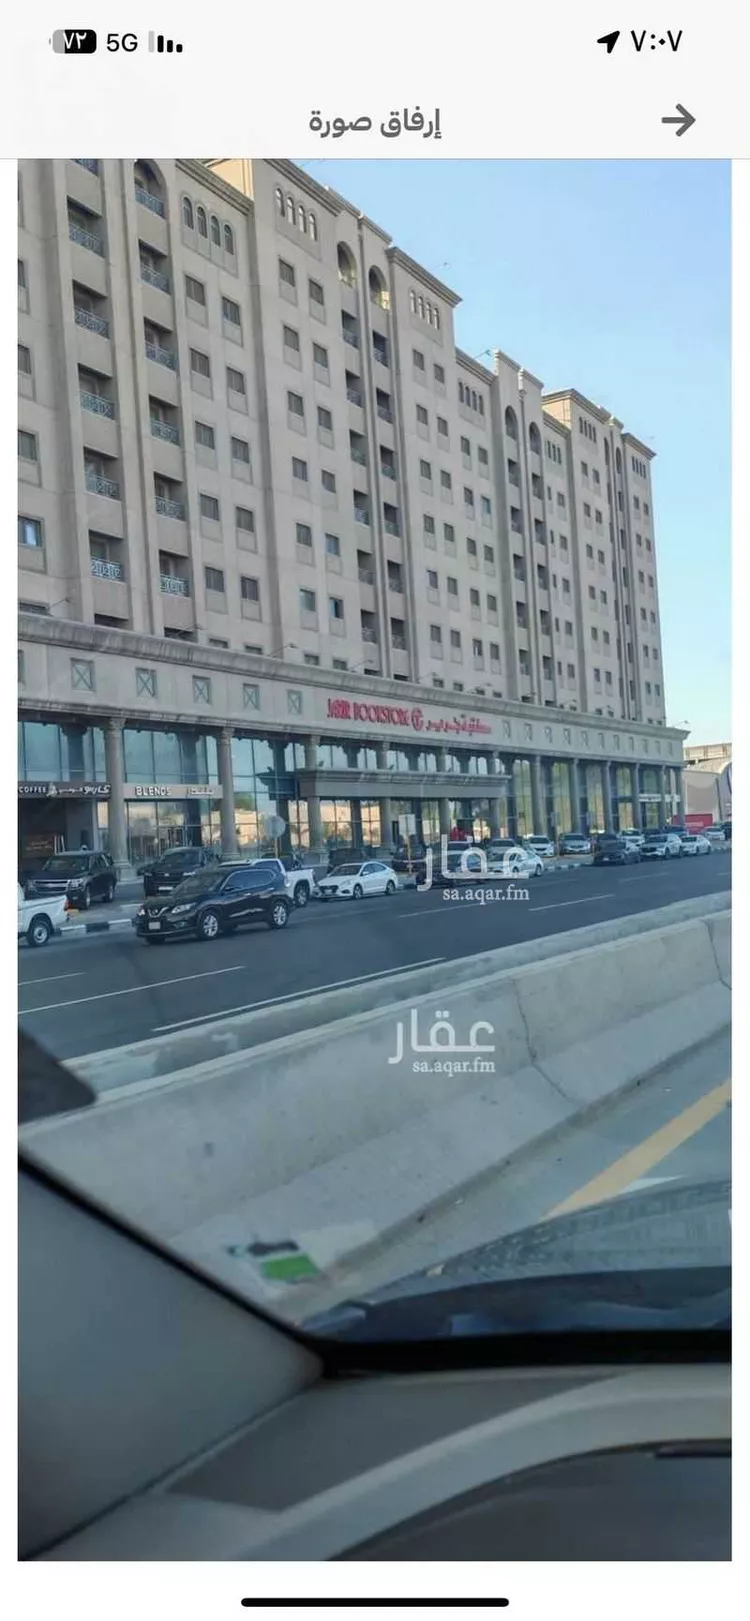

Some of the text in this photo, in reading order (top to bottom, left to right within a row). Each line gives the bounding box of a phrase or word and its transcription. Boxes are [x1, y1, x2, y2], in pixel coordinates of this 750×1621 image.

[106, 33, 138, 52] 5G
[309, 105, 442, 139] إرفاق صورة
[353, 702, 409, 726] BOOKSTORE
[18, 785, 46, 794] COFFEE
